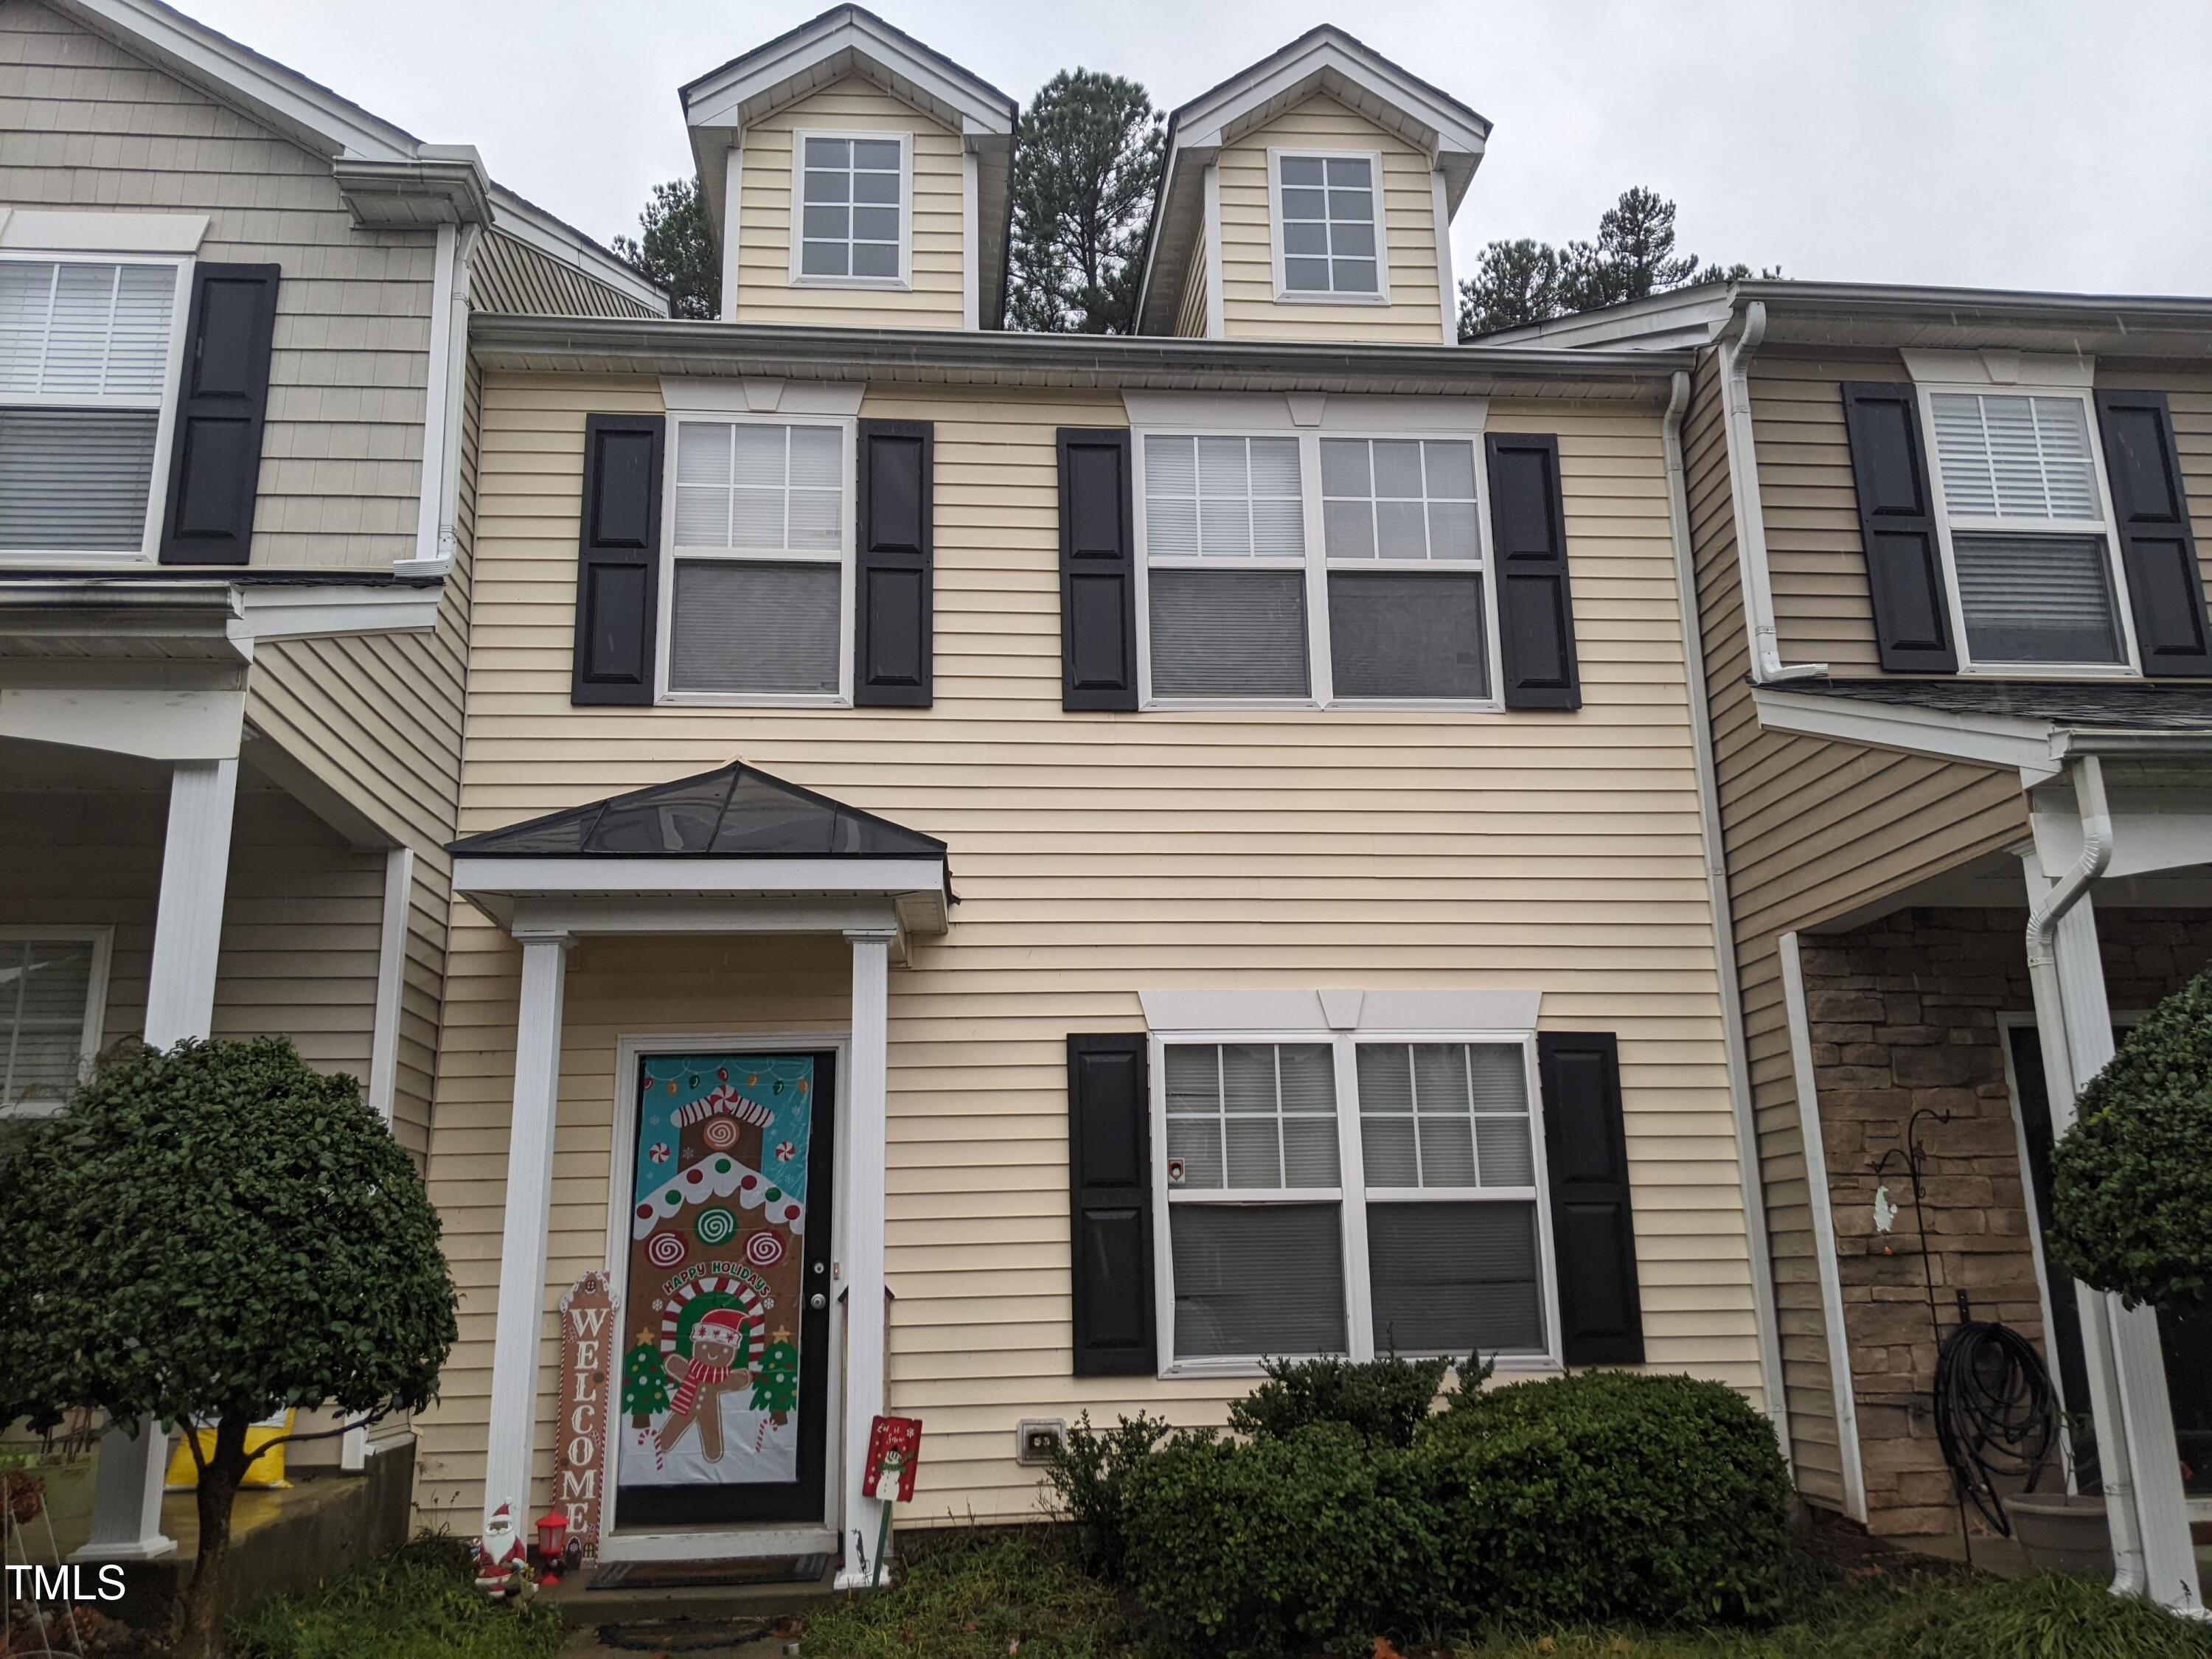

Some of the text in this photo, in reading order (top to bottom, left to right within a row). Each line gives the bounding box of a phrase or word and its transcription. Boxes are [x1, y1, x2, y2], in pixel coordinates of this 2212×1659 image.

[663, 1261, 771, 1297] HAPPY HOLIDAYS
[560, 1308, 609, 1534] WELCOME
